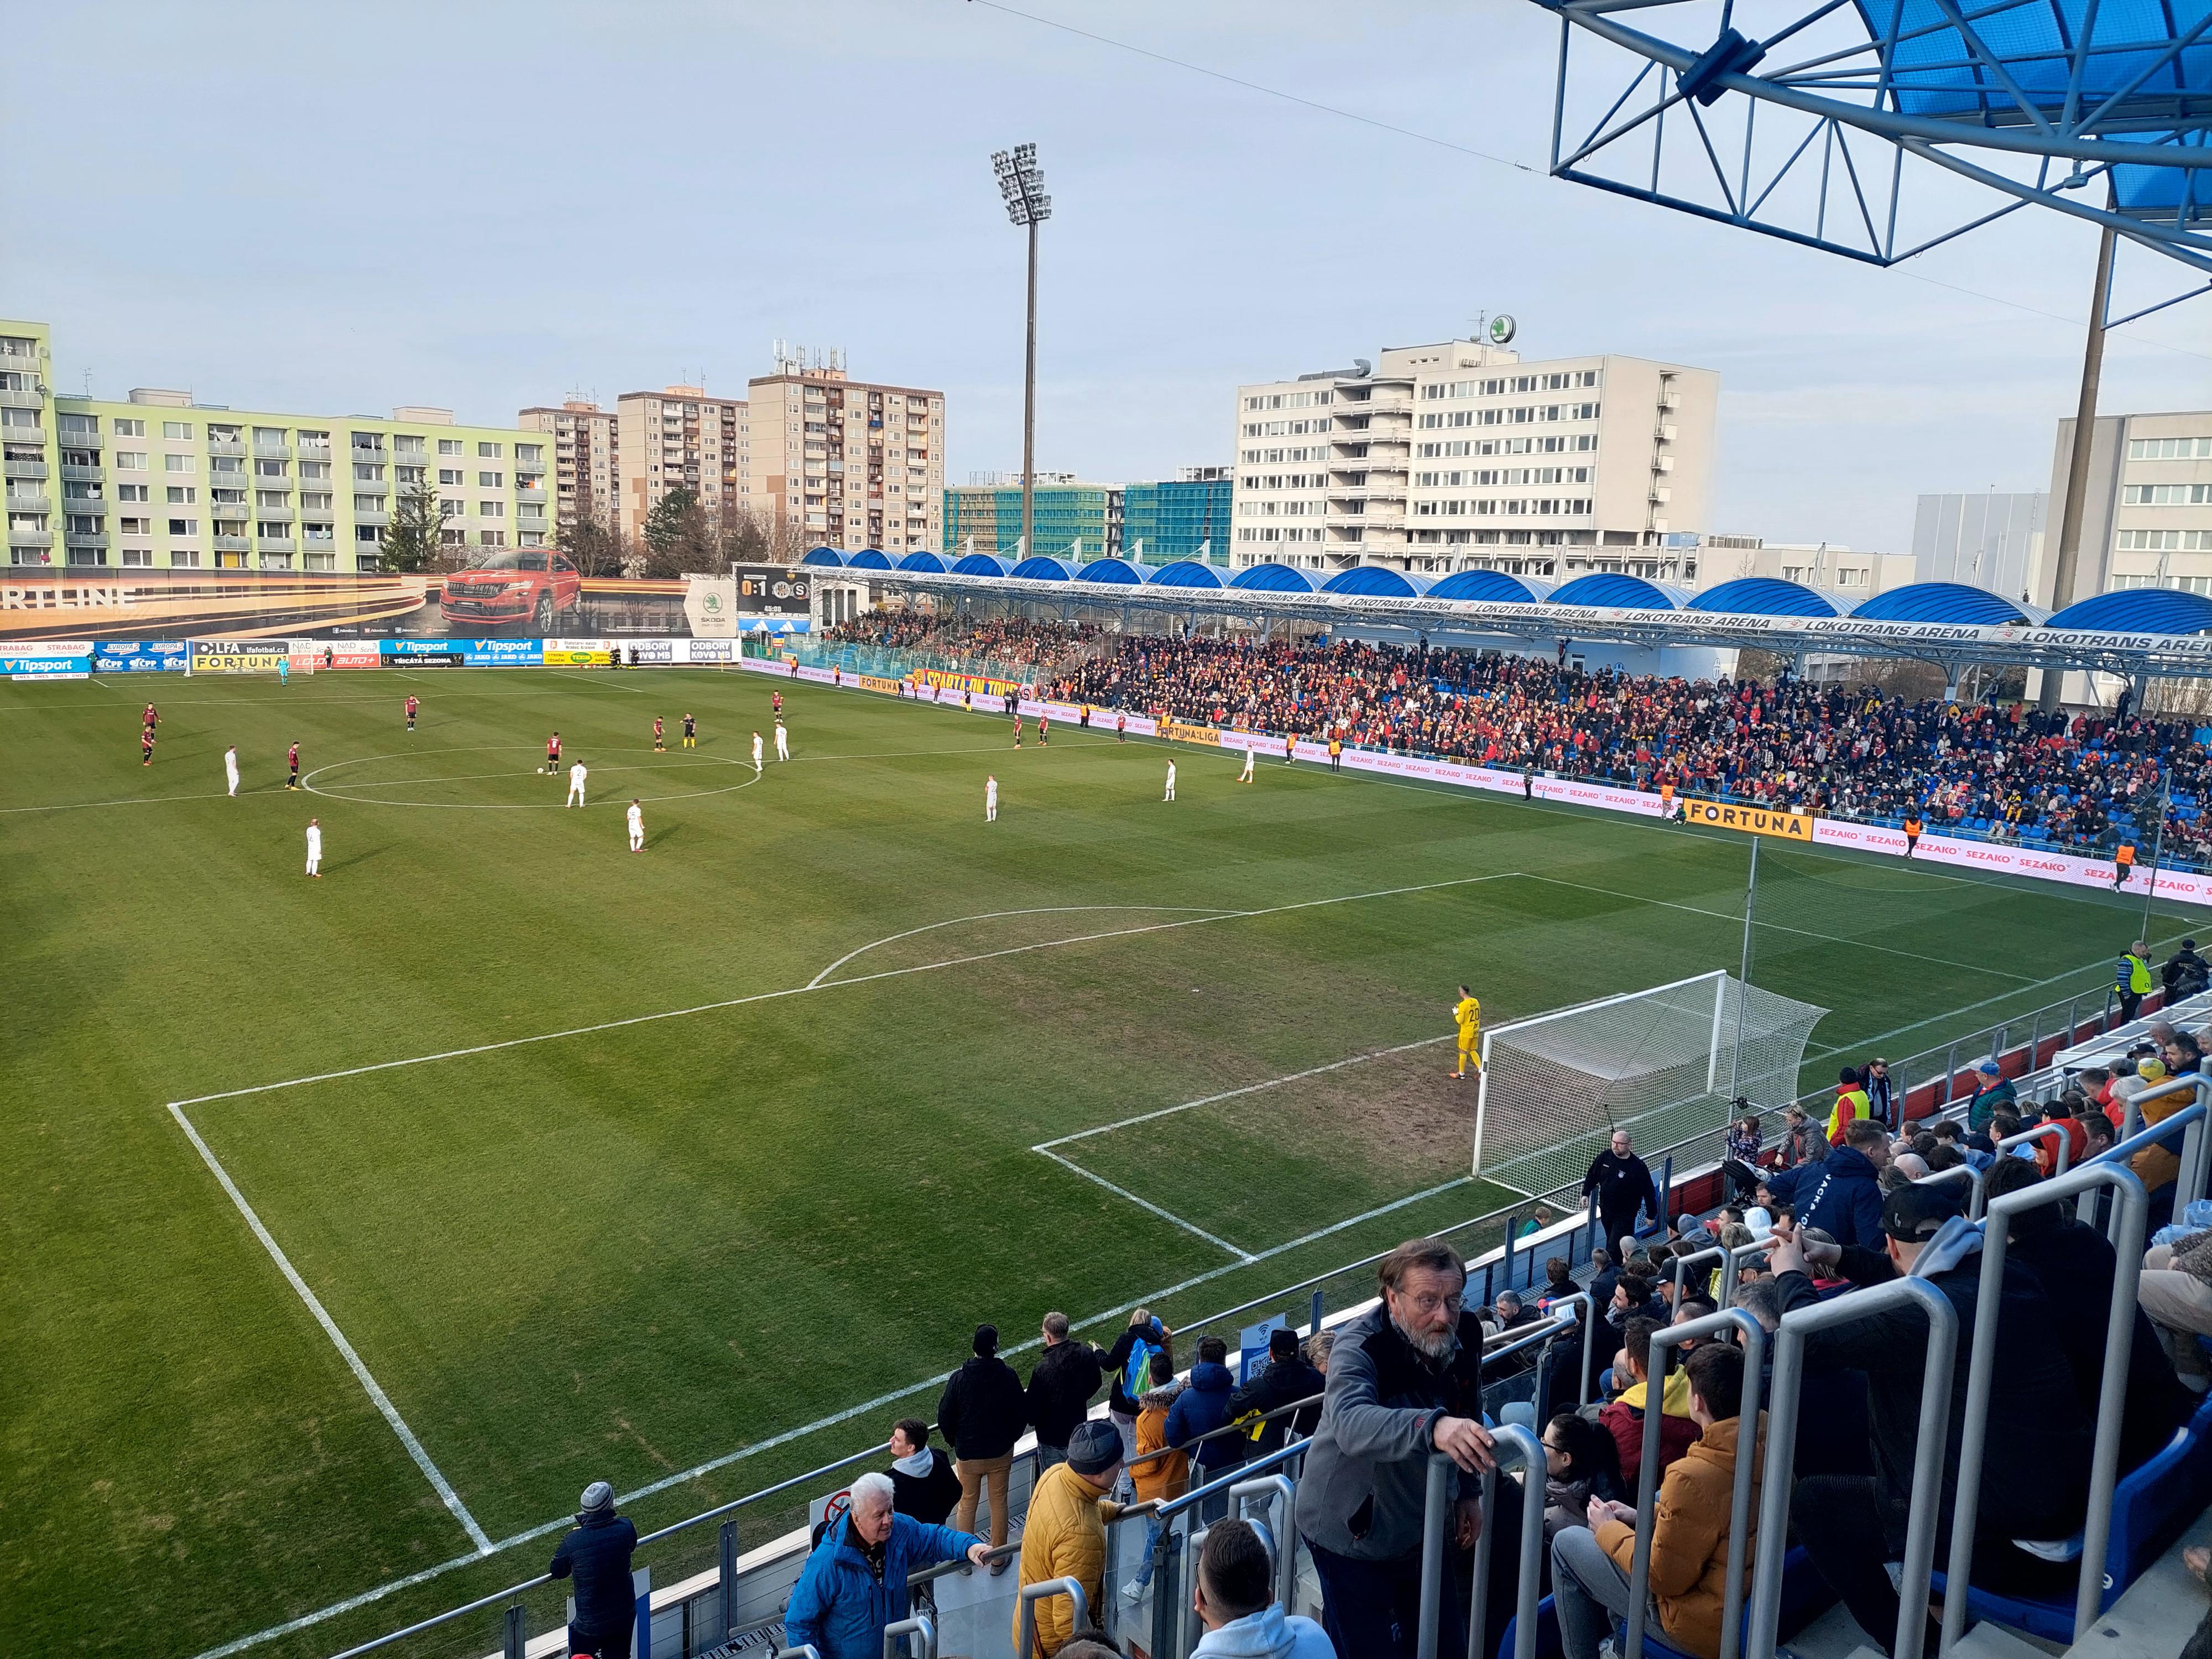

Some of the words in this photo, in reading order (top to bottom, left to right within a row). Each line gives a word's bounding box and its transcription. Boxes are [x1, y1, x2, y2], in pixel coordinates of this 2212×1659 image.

[1240, 593, 1296, 602] LOKOTRANS
[1349, 598, 1413, 608] LOKOTRANS
[1475, 604, 1549, 615] LOKOTRANS
[1624, 612, 1714, 624] LOKOTRANS
[1804, 622, 1911, 636] LOKOTRANS
[2022, 632, 2153, 649] LOKOTRANS
[216, 643, 240, 654] LFA
[406, 642, 448, 653] Tipsport
[487, 641, 533, 653] Tipsport
[19, 660, 72, 672] Tipsport
[197, 657, 281, 667] FORTUNA
[862, 678, 897, 691] FORTUNA
[1157, 725, 1219, 743] FRTUNA:LIGA
[1406, 764, 1430, 773] SEZAKO
[1435, 769, 1460, 778] SEZAKO
[1535, 784, 1563, 793] SEZAKO
[1569, 790, 1598, 799] SEZAKO
[1605, 795, 1636, 805] SEZAKO
[1642, 801, 1674, 811] SEZAO
[1691, 804, 1802, 834] FORTUNA
[1819, 828, 1858, 839] SEZAKO
[1866, 835, 1906, 847] SEZAKO
[1914, 843, 1957, 855] SEZAKO
[1966, 851, 2010, 863] SEZAKO
[2020, 859, 2066, 872] SEZAKO
[2084, 869, 2133, 883] SEZAO
[2143, 878, 2194, 891] SEZAKO
[1469, 1008, 1479, 1022] 20
